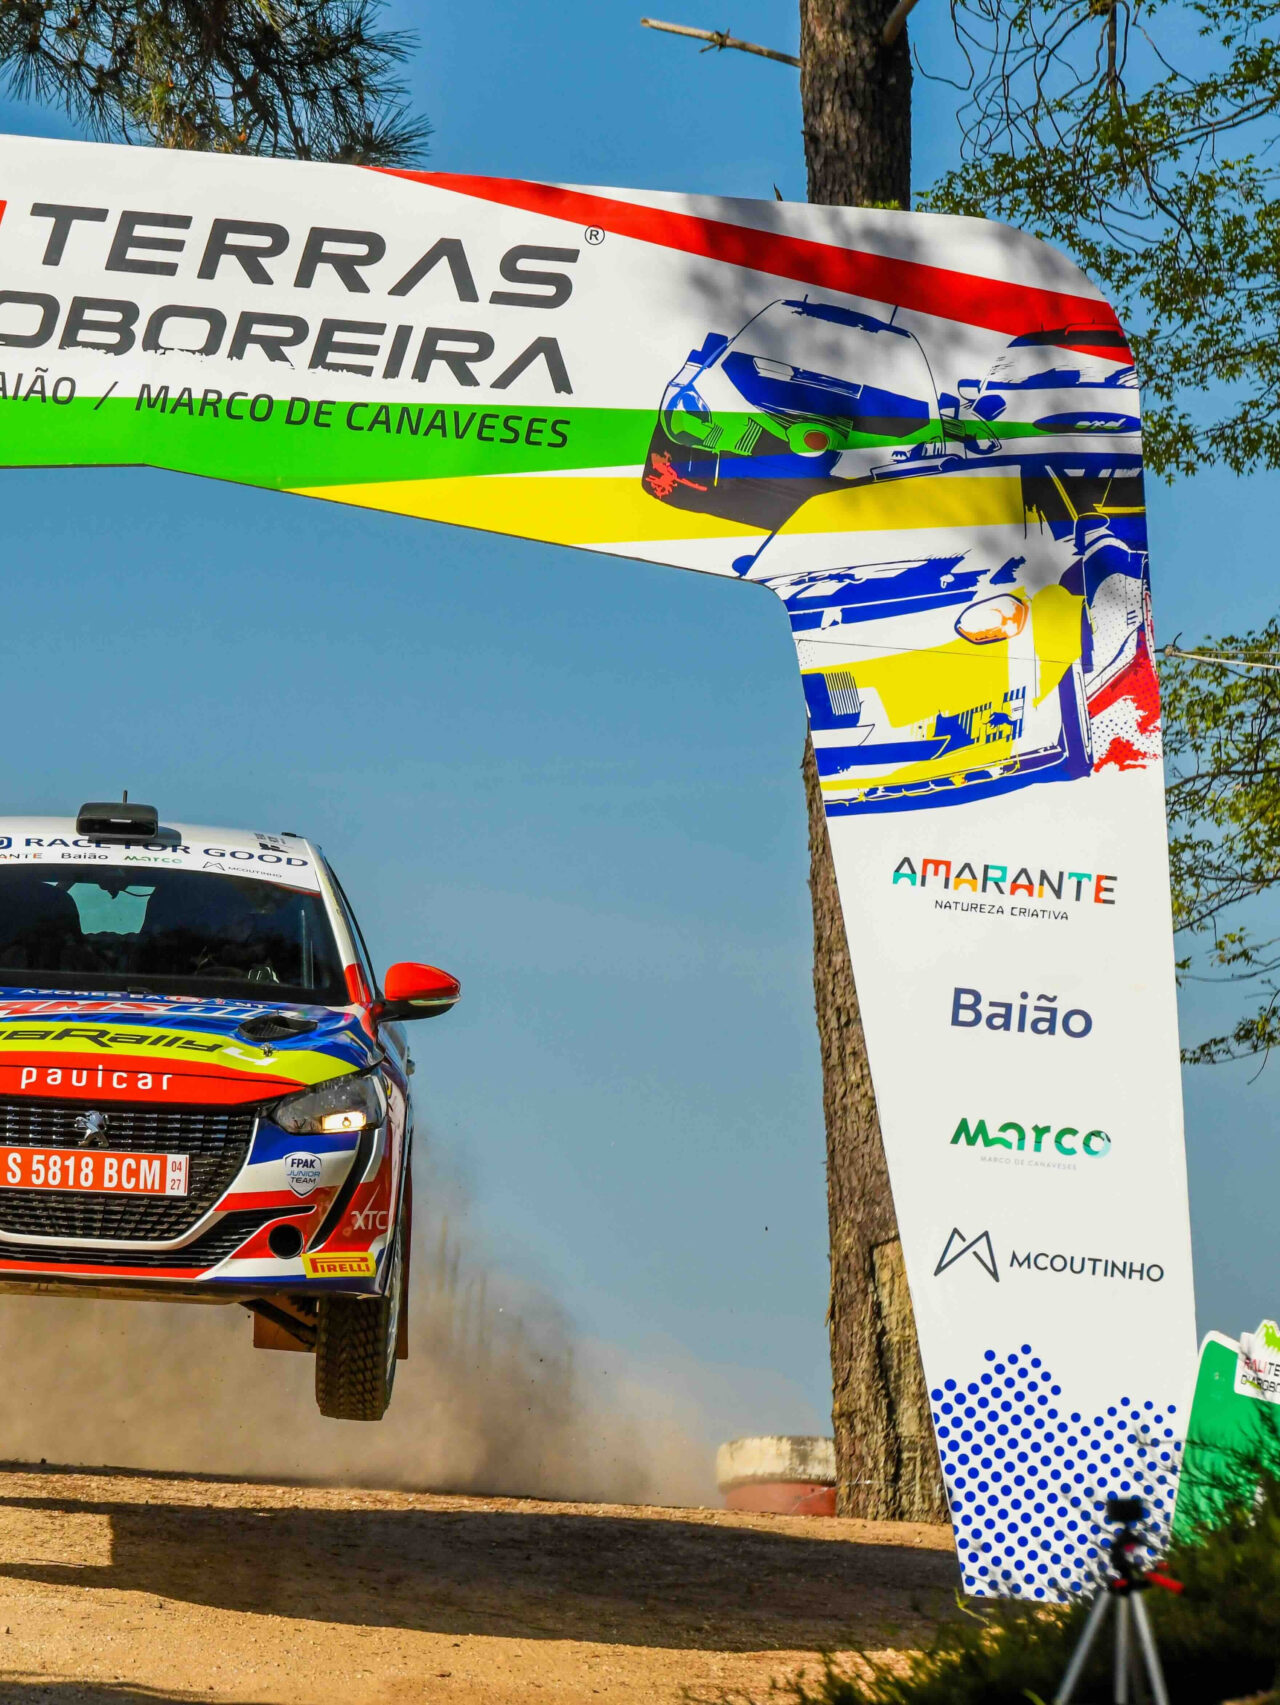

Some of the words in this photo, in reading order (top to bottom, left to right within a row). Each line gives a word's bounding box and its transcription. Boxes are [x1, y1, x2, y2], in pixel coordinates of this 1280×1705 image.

[29, 202, 581, 309] TERRAS
[134, 384, 274, 422] MARCO
[285, 396, 336, 428] DE
[346, 402, 571, 449] CANAVESES
[61, 852, 109, 860] Baião
[228, 866, 282, 878] MCOUTINHO
[203, 848, 309, 867] GOOD
[892, 856, 1118, 905] AMARANTE
[934, 899, 1005, 915] NATUREZA
[1010, 906, 1069, 921] CRIATIVA
[950, 986, 1093, 1039] Baião
[20, 1064, 174, 1090] pauicar
[949, 1117, 1112, 1159] Marco
[6, 1152, 22, 1185] S
[31, 1154, 94, 1188] 5818
[103, 1157, 161, 1190] BCM
[171, 1160, 182, 1173] 04
[286, 1170, 321, 1178] JUNIOR
[290, 1158, 317, 1169] FPAK
[980, 1156, 1011, 1165] MARCO
[1014, 1158, 1025, 1166] DE
[1027, 1160, 1078, 1170] CANAVESES
[170, 1178, 182, 1191] 27
[309, 1256, 371, 1273] PIRELLI
[1009, 1250, 1165, 1282] MCOUTINHO
